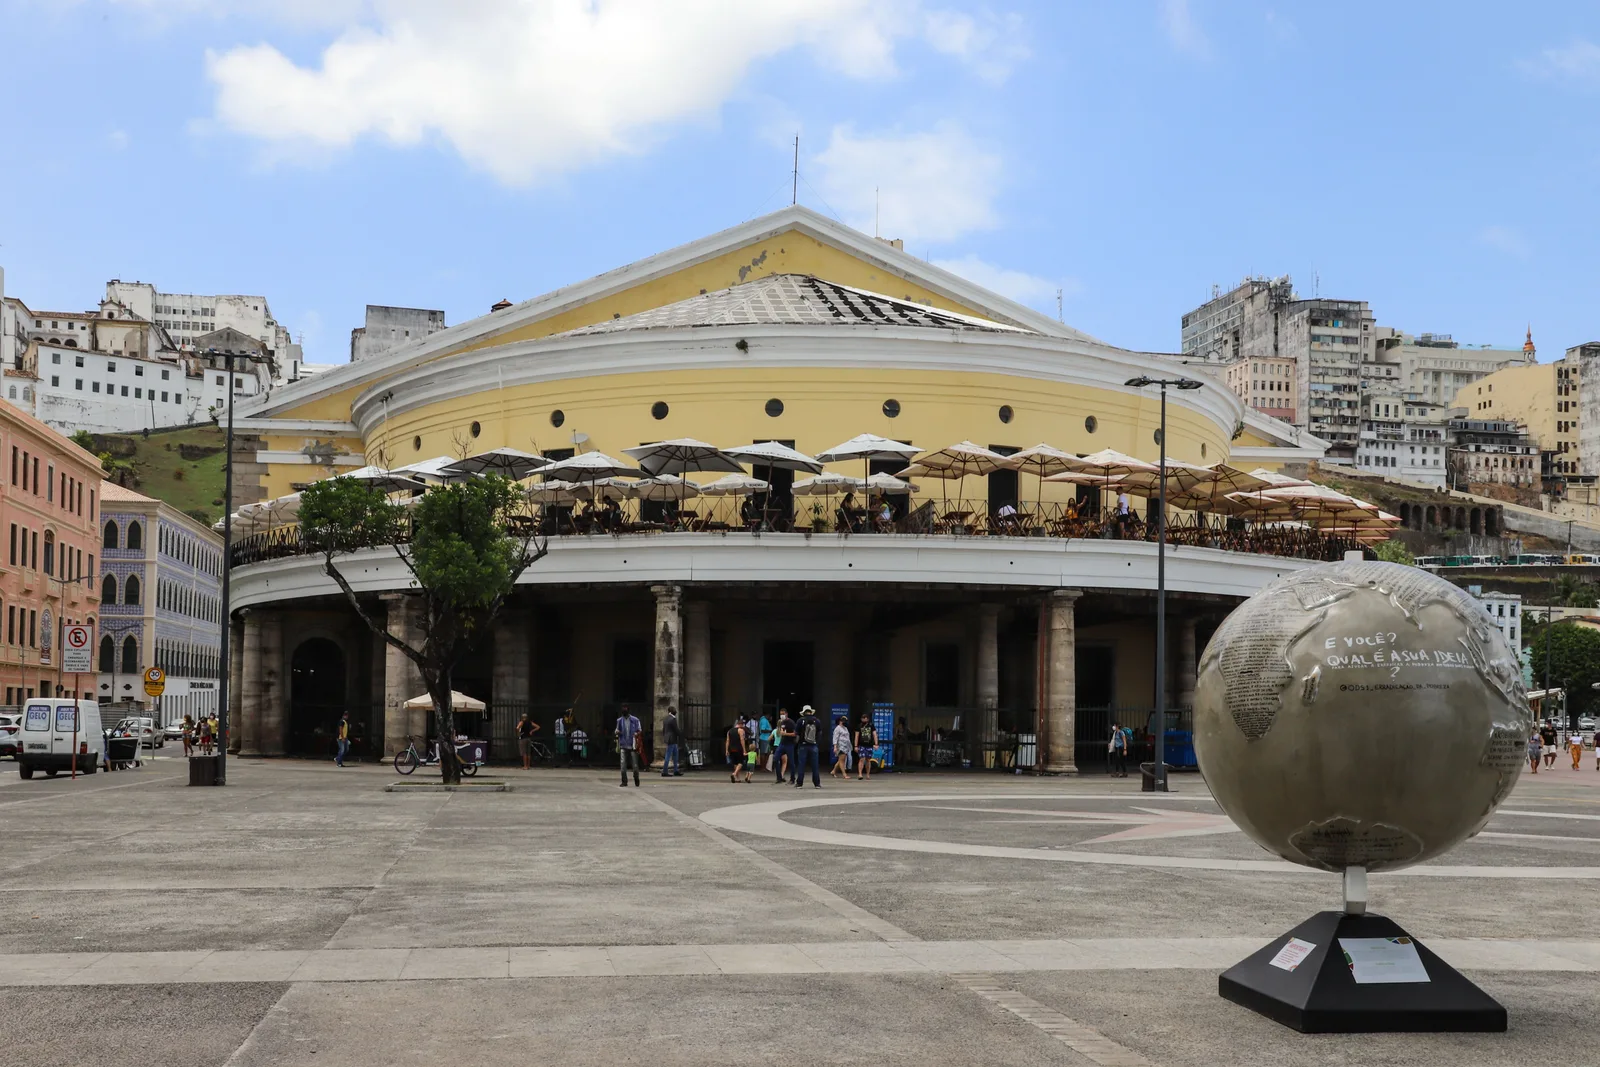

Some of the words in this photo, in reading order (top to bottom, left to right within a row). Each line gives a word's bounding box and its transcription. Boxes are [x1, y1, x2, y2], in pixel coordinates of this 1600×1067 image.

[1325, 637, 1336, 649] E
[1344, 632, 1397, 648] VOCÊ?
[1327, 655, 1372, 667] QUAL
[1373, 648, 1385, 662] É
[1433, 650, 1469, 665] IDEIA
[1390, 666, 1400, 682] ?
[29, 711, 47, 720] GELO
